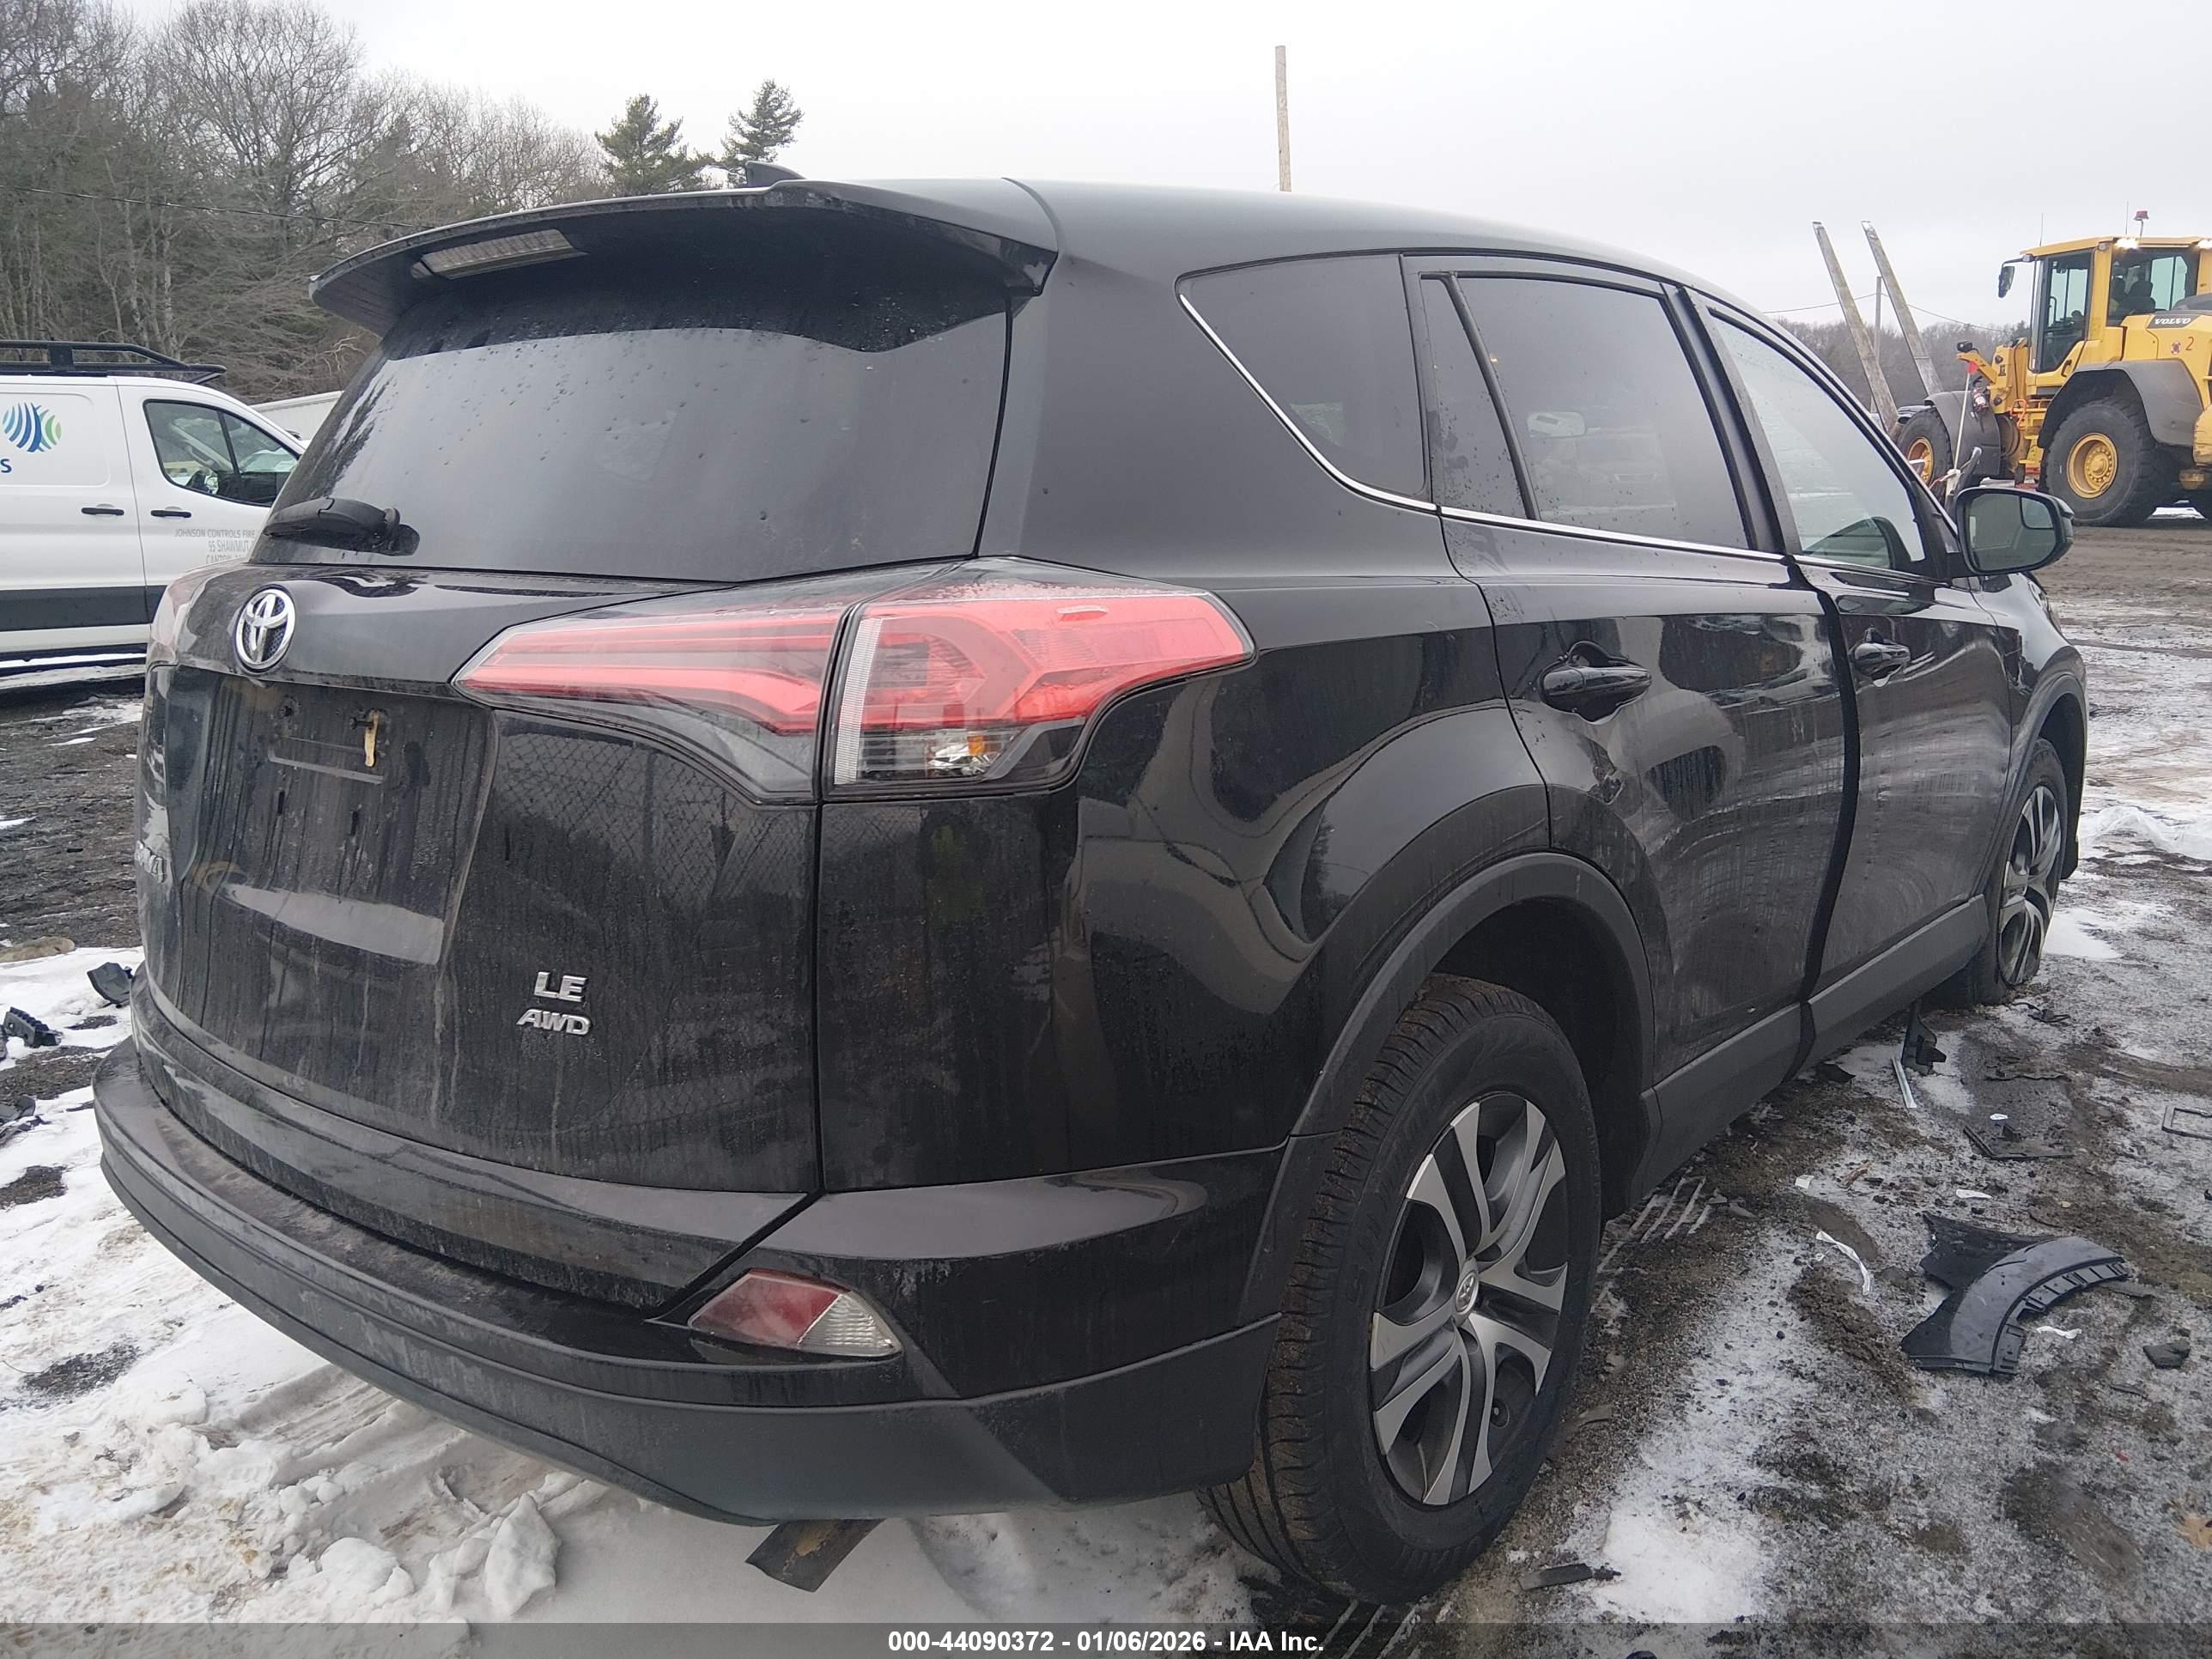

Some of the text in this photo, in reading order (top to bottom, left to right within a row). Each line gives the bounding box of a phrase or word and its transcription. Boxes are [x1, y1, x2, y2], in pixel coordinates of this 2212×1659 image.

[2185, 337, 2195, 351] 2
[174, 528, 256, 538] JOHNSON CONTROLS FIRE
[534, 971, 587, 1003] LE
[516, 1008, 591, 1035] AWD
